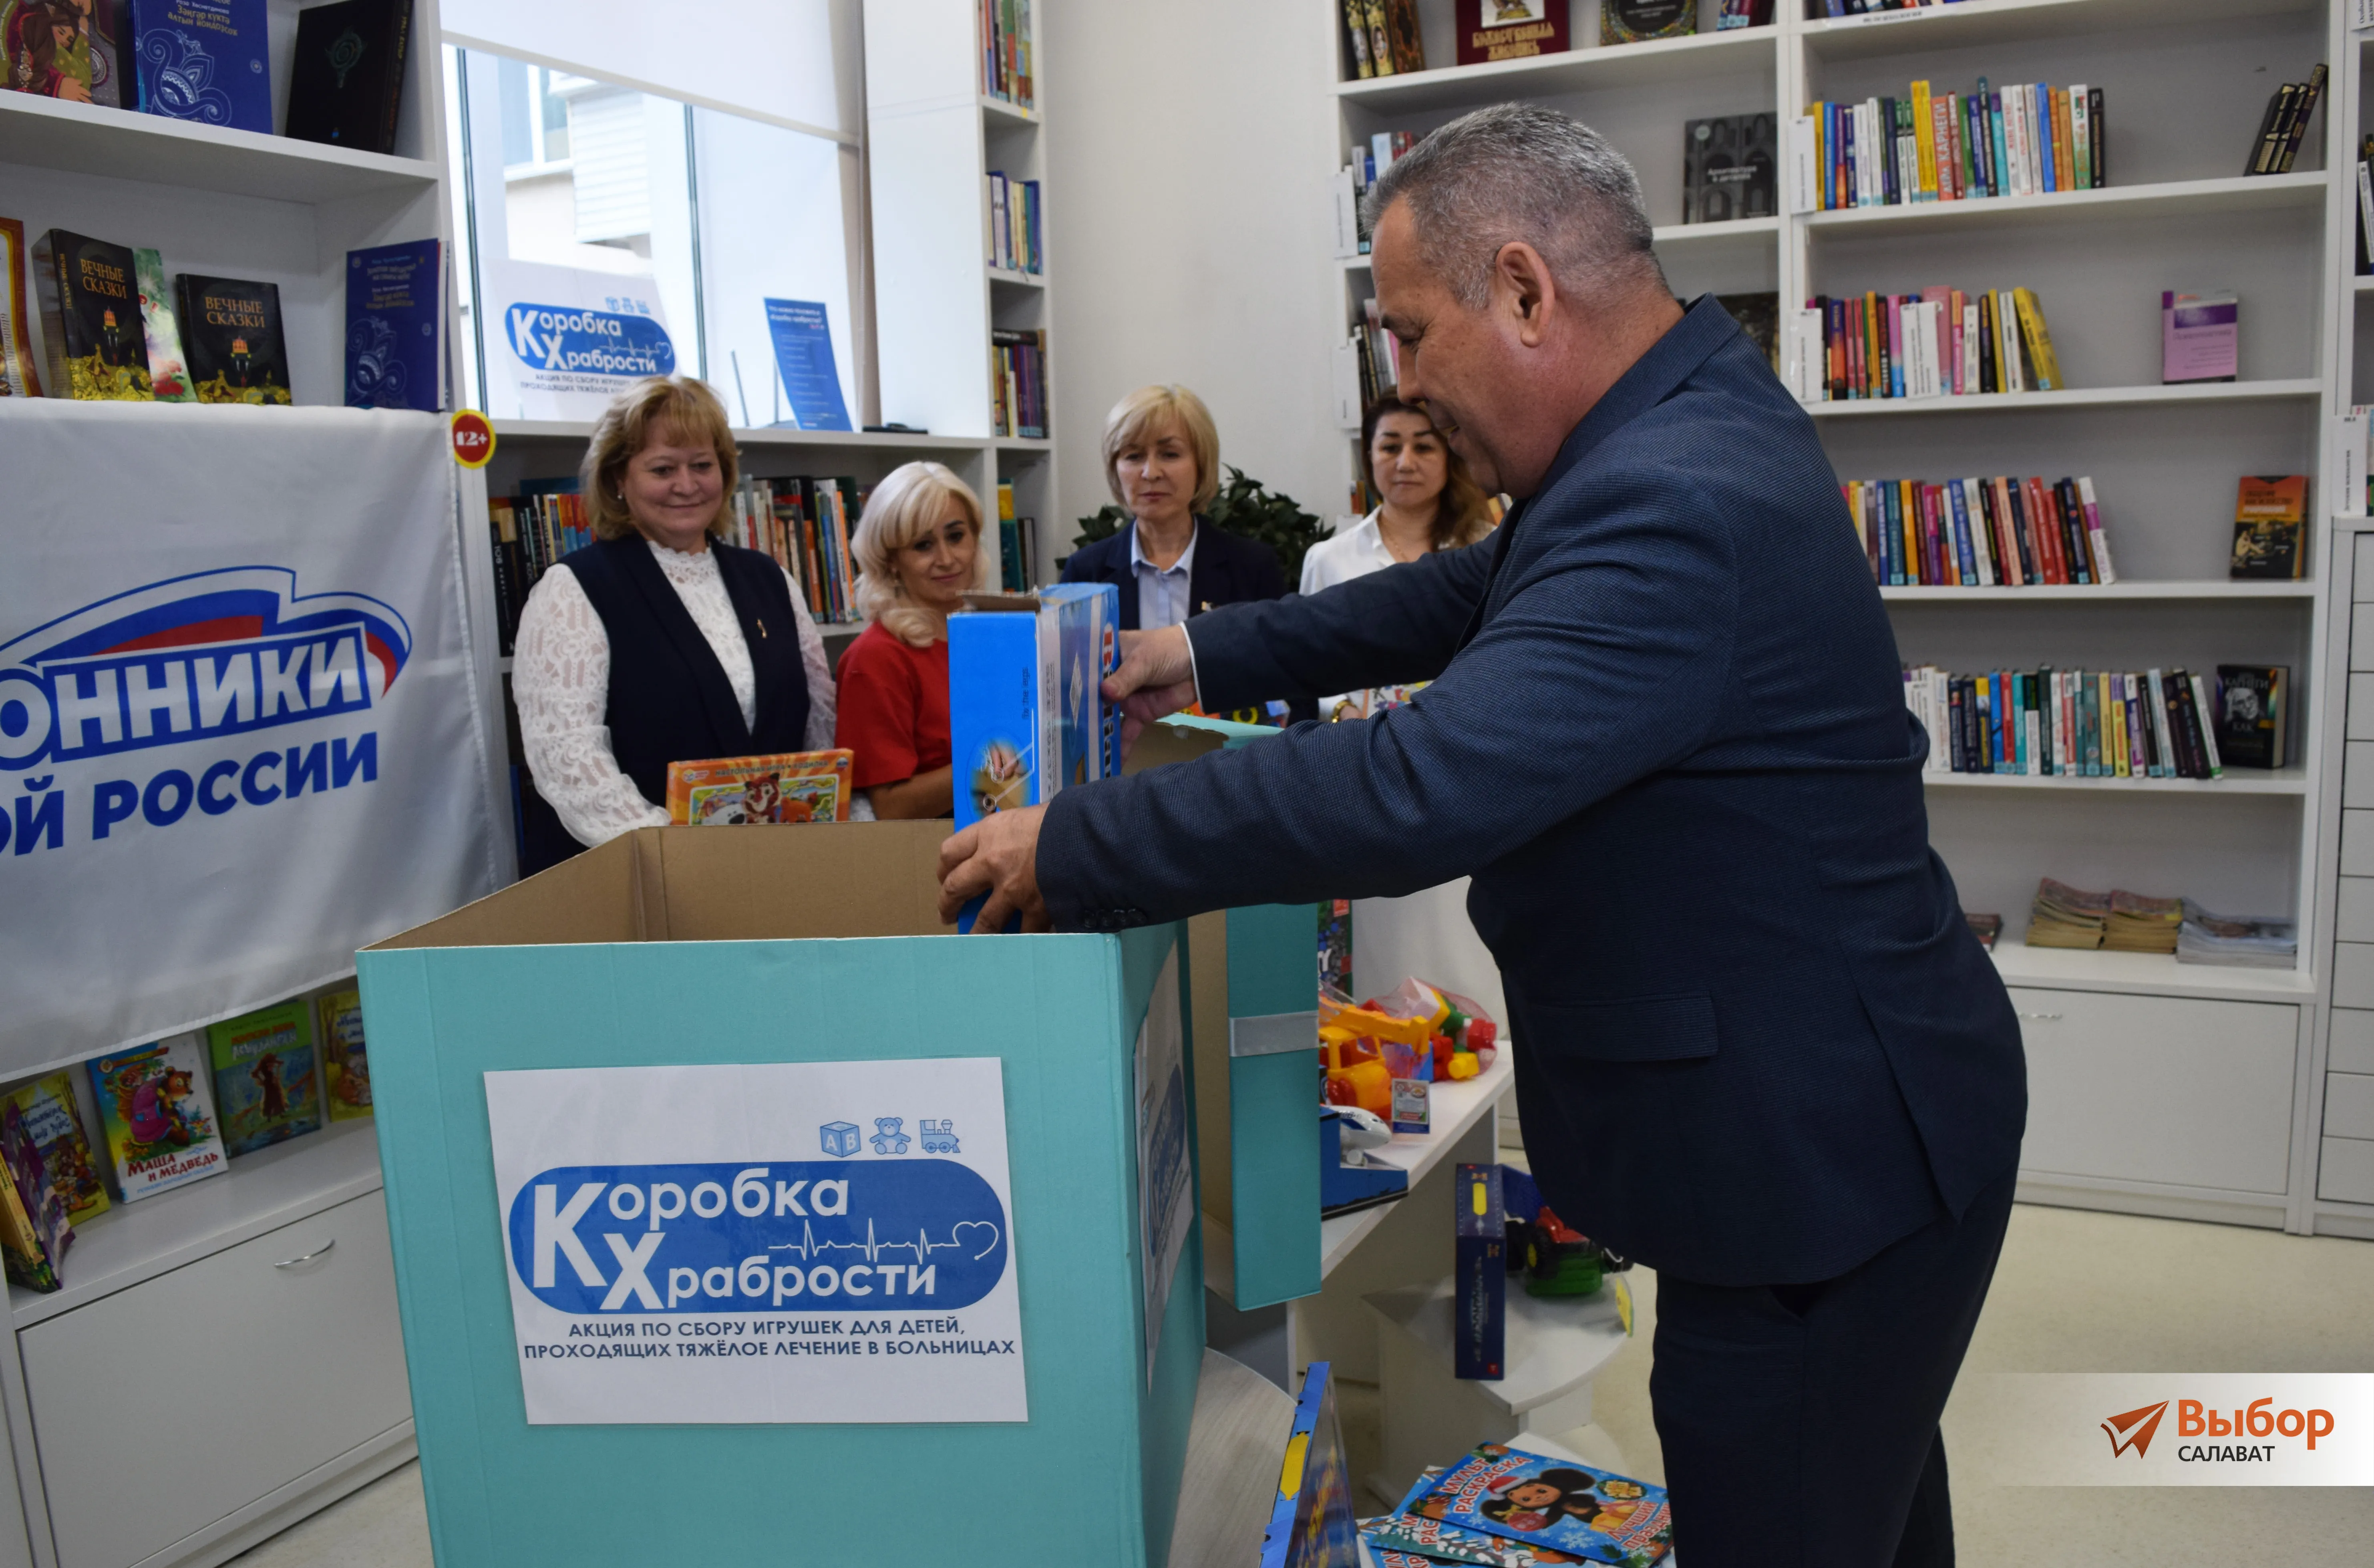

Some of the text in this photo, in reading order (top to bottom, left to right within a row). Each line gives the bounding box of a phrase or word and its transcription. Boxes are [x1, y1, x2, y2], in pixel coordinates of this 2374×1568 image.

[80, 258, 125, 283] ВЕЧНЫЕ
[82, 276, 128, 300] СКАЗКИ
[205, 296, 264, 314] ВЕЧНЫЕ
[206, 311, 266, 328] СКАЗКИ
[511, 308, 622, 358] Коробка
[540, 334, 657, 373] Храбрости
[456, 431, 488, 446] 12+
[715, 767, 765, 777] НАСТОЛЬНАЯ
[767, 764, 785, 772] ИГРА
[0, 731, 378, 857] Й РОССИИ
[533, 1168, 849, 1287] Коробка
[600, 1231, 936, 1310] Храбрости
[569, 1316, 966, 1339] АКЦИЯ ПО СБОРУ ИГРУШЕК ДЛЯ ДЕТЕЙ,
[524, 1338, 1016, 1360] ПРОХОДЯЩИХ ТЯЖЁЛОЕ ЛЕЧЕНИЕ В БОЛЬНИЦАХ
[1440, 1457, 1492, 1494] МУЛЬТ
[1453, 1456, 1534, 1514] РАСКРАСКА
[1606, 1501, 1659, 1542] Лучший
